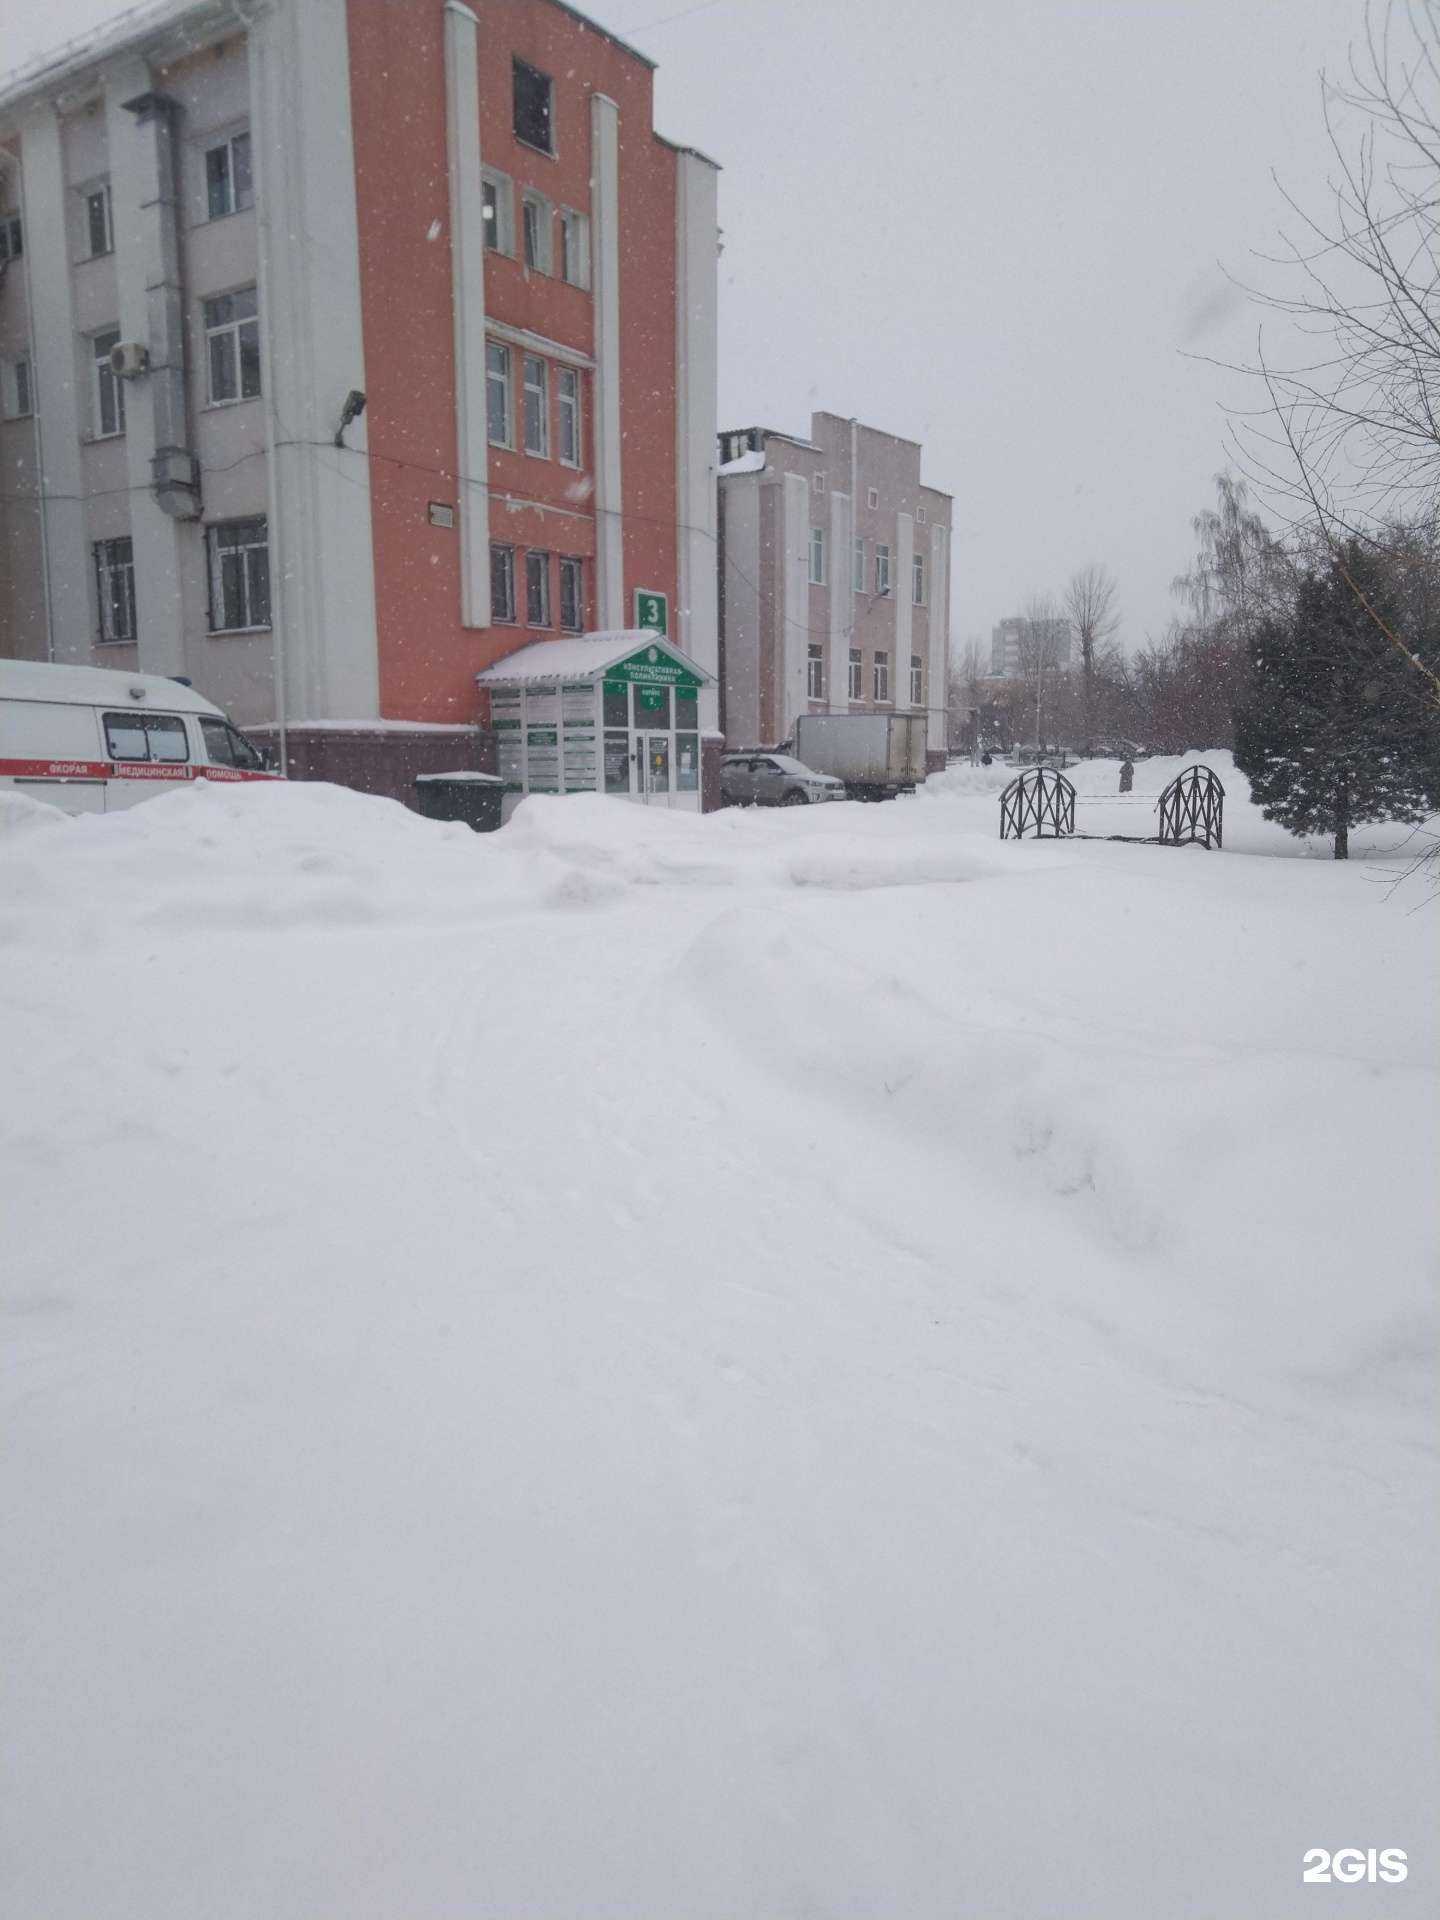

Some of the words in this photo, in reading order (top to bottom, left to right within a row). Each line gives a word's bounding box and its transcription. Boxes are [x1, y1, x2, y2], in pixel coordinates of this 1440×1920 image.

[646, 599, 659, 623] 3
[49, 763, 88, 775] СКОРАЯ
[118, 765, 184, 778] МЕДИЦИНСКАЯ
[206, 768, 242, 780] ПОМОЩЬ
